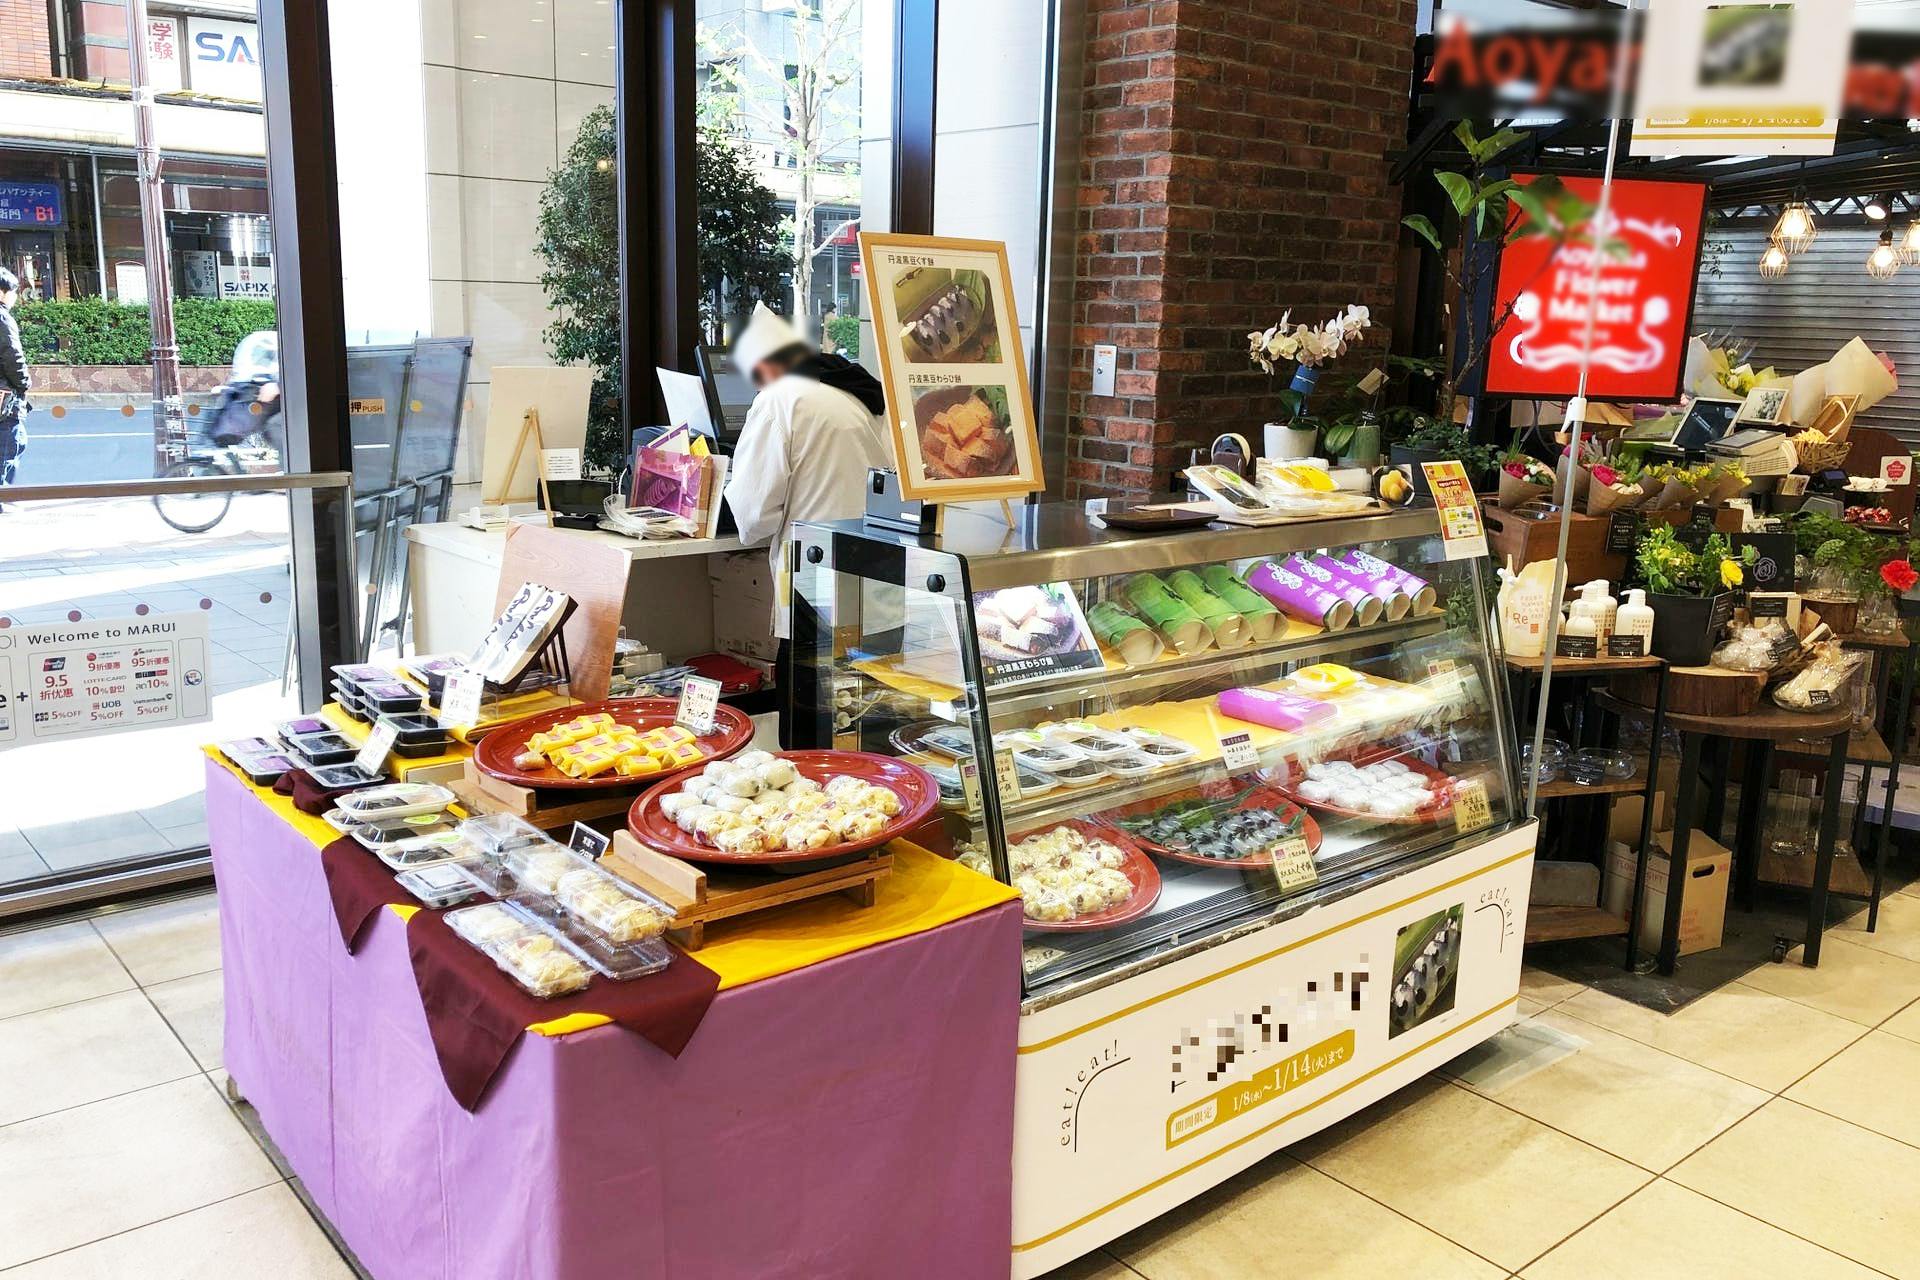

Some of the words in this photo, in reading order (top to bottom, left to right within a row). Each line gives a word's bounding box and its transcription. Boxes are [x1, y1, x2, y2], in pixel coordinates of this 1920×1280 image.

[36, 206, 54, 221] B1
[224, 282, 269, 293] SAPIX
[362, 405, 383, 413] PUSH
[27, 632, 99, 645] Welcome
[106, 629, 121, 638] to
[127, 622, 176, 636] MARUI
[44, 674, 68, 688] 9.5
[101, 700, 122, 710] UOB
[1060, 1087, 1078, 1147] eat!
[1077, 1039, 1120, 1083] eat!
[1175, 1106, 1213, 1134] 期間限定
